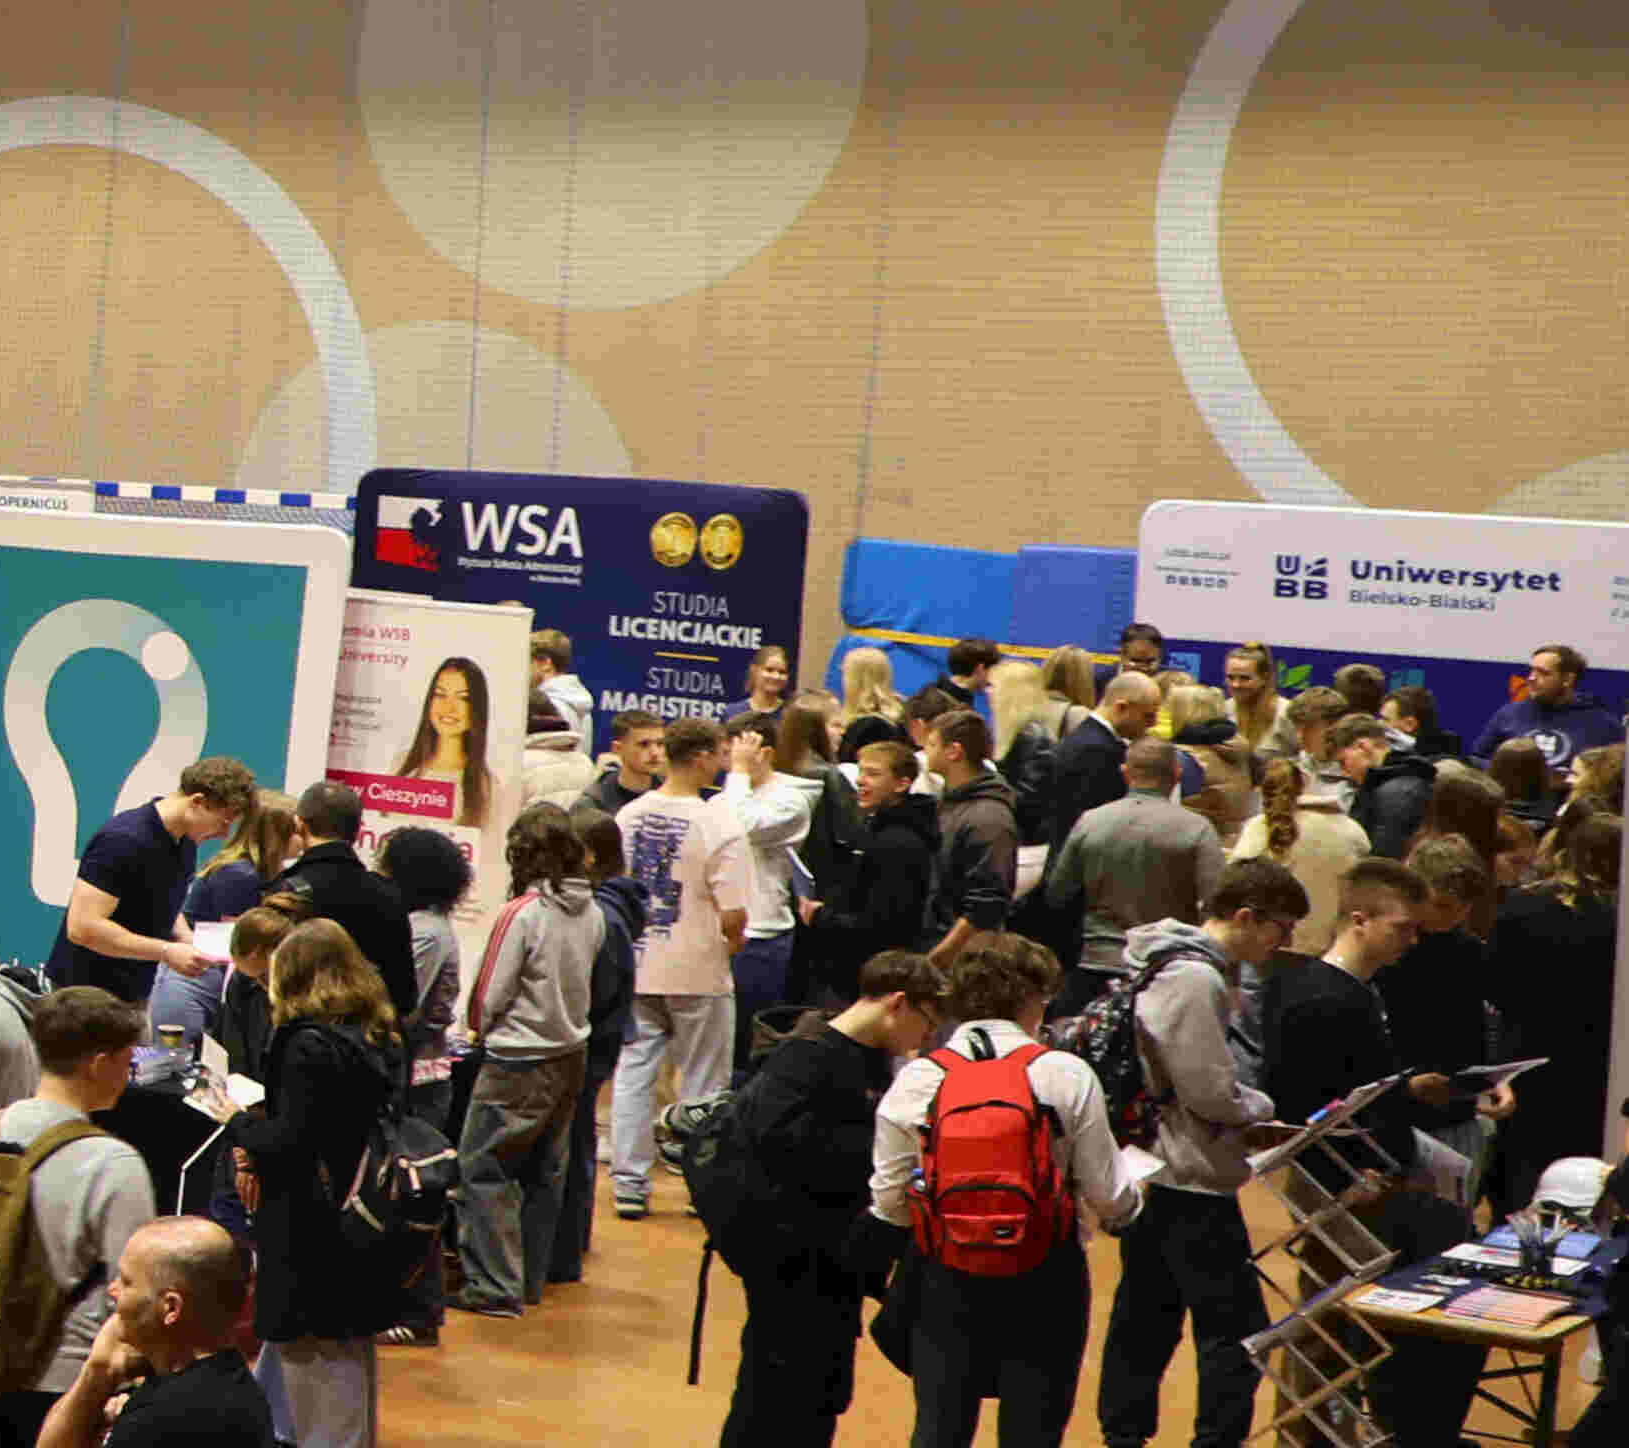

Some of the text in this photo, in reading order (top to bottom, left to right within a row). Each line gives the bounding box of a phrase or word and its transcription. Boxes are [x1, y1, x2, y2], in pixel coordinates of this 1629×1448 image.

[462, 501, 584, 559] WSA
[1350, 558, 1563, 593] Uniwersytet
[652, 591, 730, 618] STUDIA
[1348, 588, 1497, 613] Bielsko-Bialski
[379, 627, 411, 641] WSB
[608, 615, 762, 649] LICENCJACKIE
[647, 666, 725, 695] STUDIA
[366, 782, 449, 809] Cieszynie
